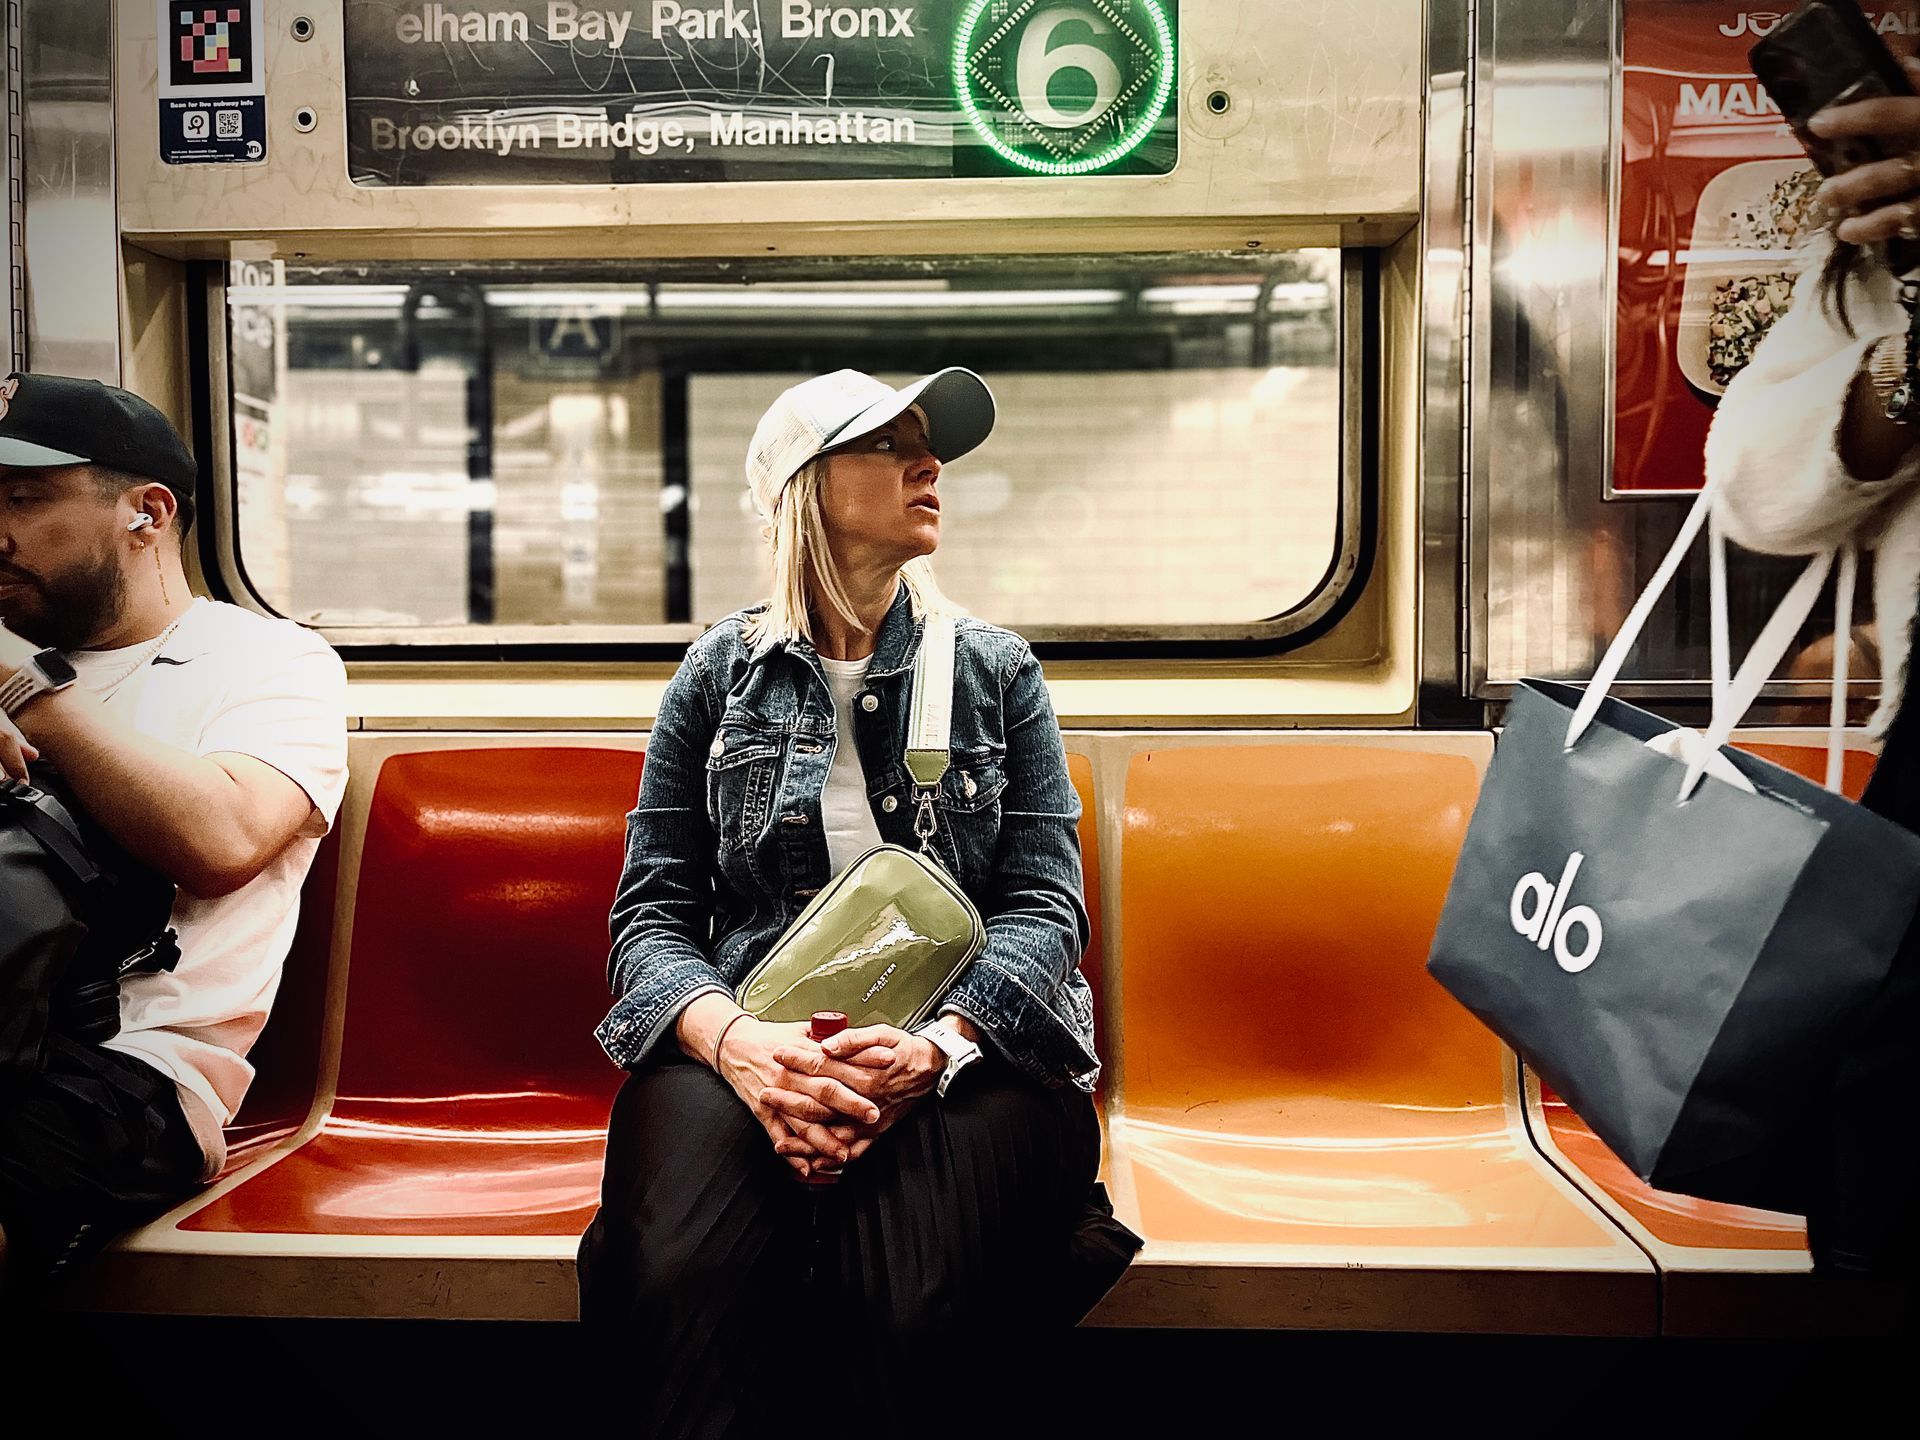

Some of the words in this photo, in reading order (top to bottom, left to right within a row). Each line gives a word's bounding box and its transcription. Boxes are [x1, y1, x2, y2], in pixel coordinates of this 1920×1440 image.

[396, 2, 529, 43] elham
[547, 1, 633, 49] Bay
[652, 0, 760, 48] Park,
[781, 0, 915, 39] Bronx
[1719, 12, 1793, 37] JU
[1016, 7, 1122, 129] 6
[213, 100, 239, 108] subway
[371, 114, 541, 157] Brooklyn
[556, 112, 695, 155] Bridge,
[710, 111, 916, 145] Manhattan
[1510, 850, 1603, 973] alo
[861, 962, 897, 1003] LANCASTER
